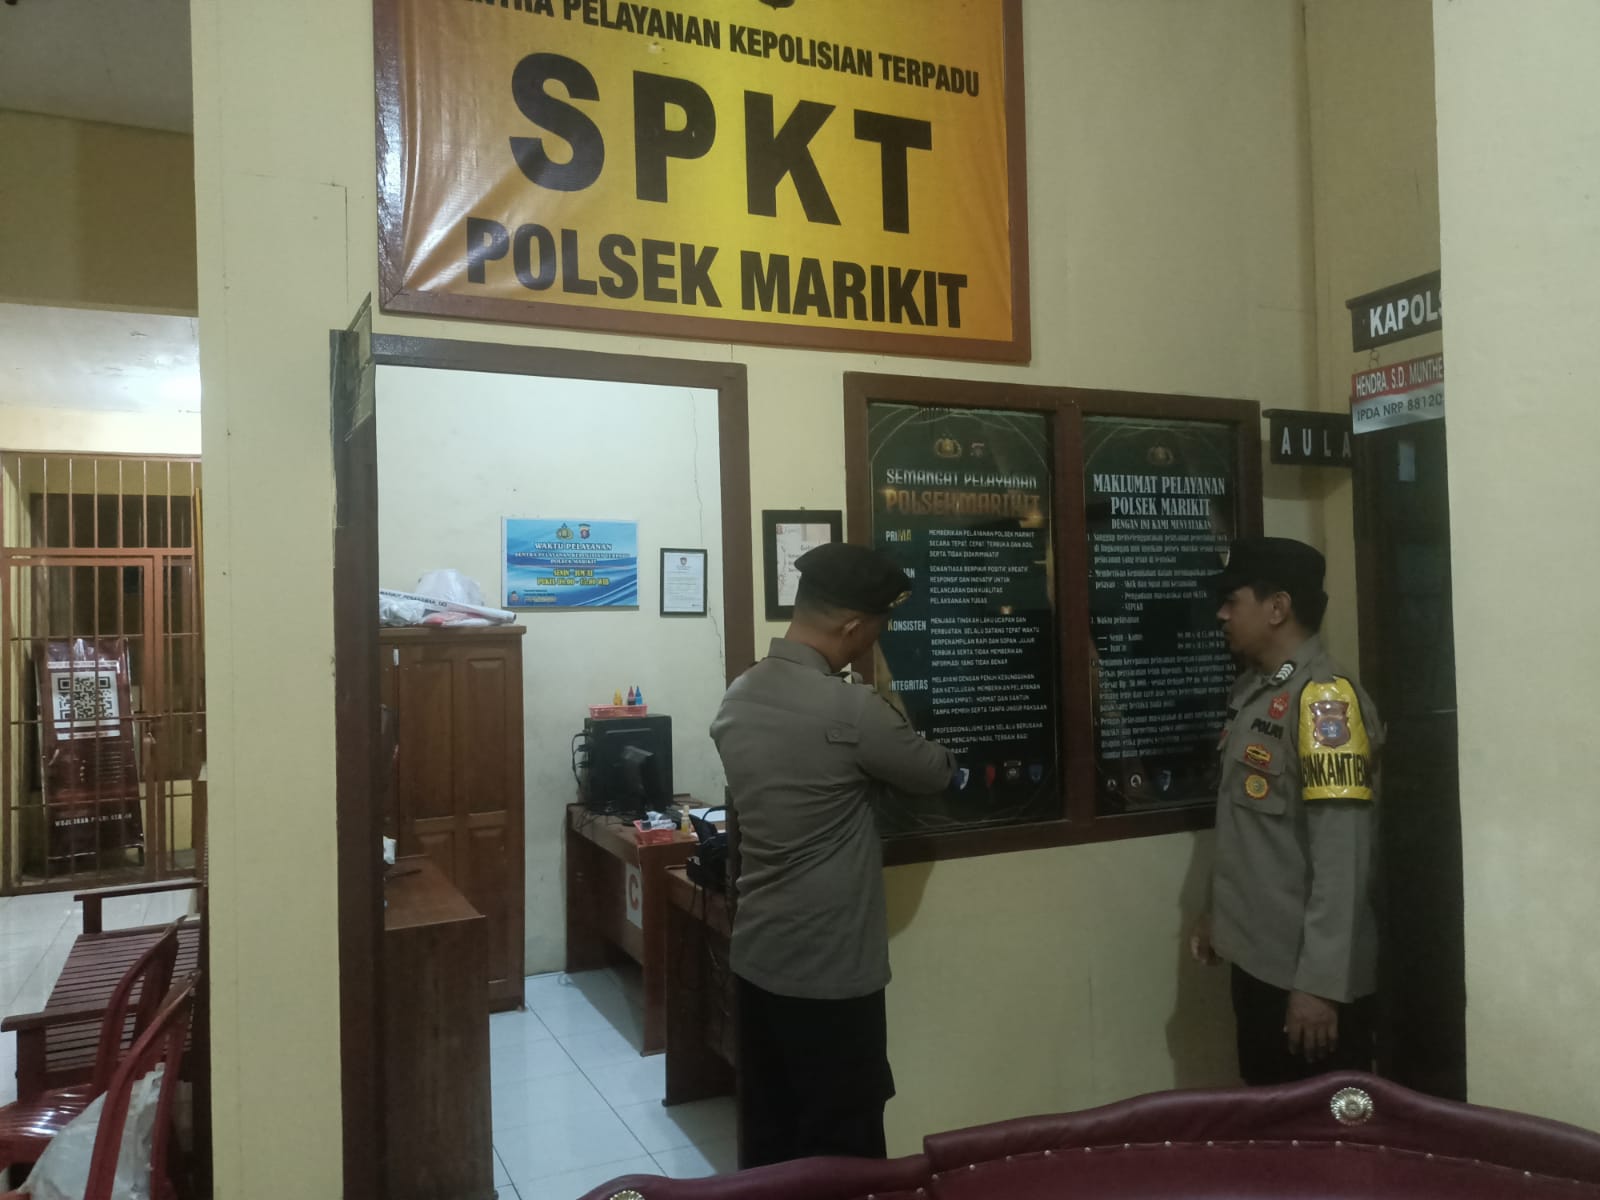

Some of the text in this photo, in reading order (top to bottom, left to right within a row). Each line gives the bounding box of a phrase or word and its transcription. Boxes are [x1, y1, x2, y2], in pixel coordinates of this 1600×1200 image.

[564, 0, 979, 97] PELAYANAN KEPOLISIAN TERPADU
[509, 52, 932, 234] SPKT
[466, 217, 967, 328] POLSEK MARIKIT
[1391, 366, 1407, 389] S.D.
[1409, 357, 1443, 384] MUNTHE
[1357, 393, 1442, 421] IPDA NRP 88120
[886, 468, 1037, 488] SEMANGAT PELAYANAN
[1093, 474, 1225, 496] MAKLUMAT PELAYANAN
[1110, 496, 1211, 516] POLSEK MARIKIT
[885, 528, 912, 542] PRIMA
[1112, 519, 1138, 530] DENGAN
[888, 620, 926, 631] KONSISTEN
[889, 680, 928, 691] INTEGRITAS
[628, 873, 639, 910] C
